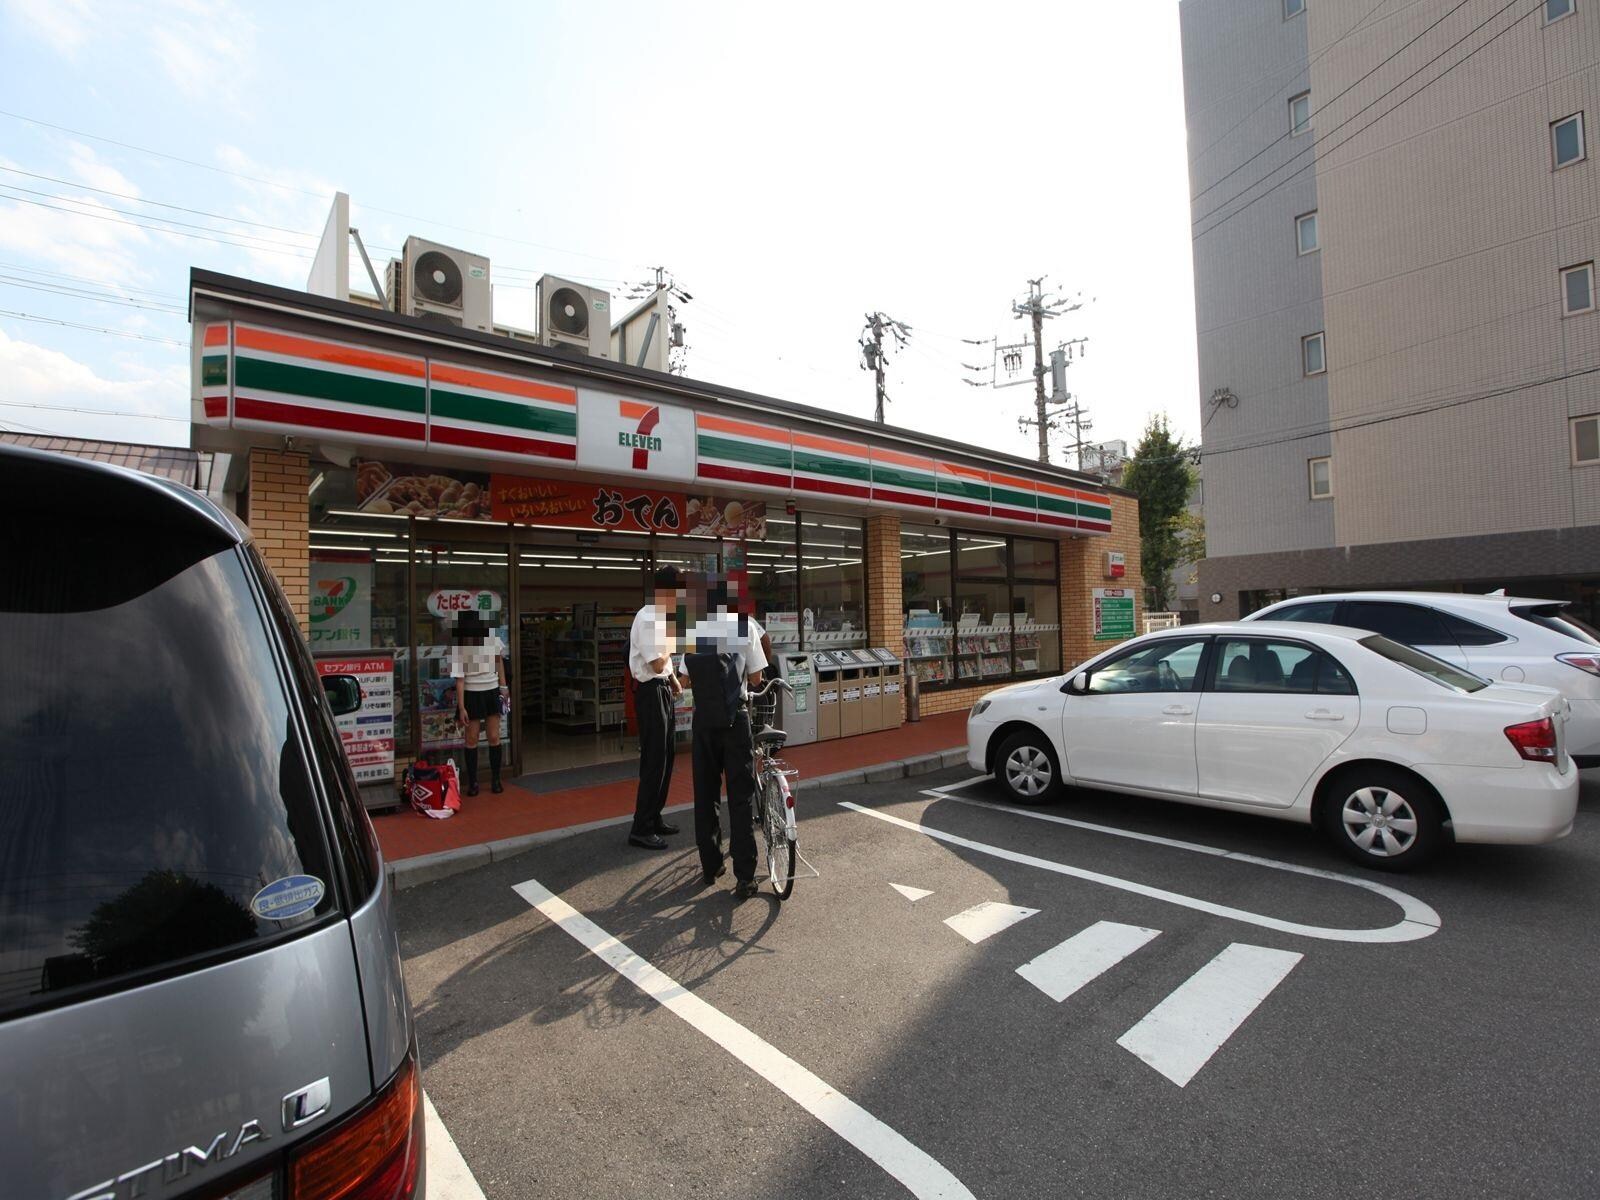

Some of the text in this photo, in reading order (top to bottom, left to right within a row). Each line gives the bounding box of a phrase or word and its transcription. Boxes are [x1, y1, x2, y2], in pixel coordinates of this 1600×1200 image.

[619, 400, 659, 470] 7
[509, 499, 587, 519] いろいろおいしい
[592, 487, 680, 530] おでん
[437, 594, 492, 610] たばこ 酒
[324, 662, 385, 672] セブン銀行 ATM
